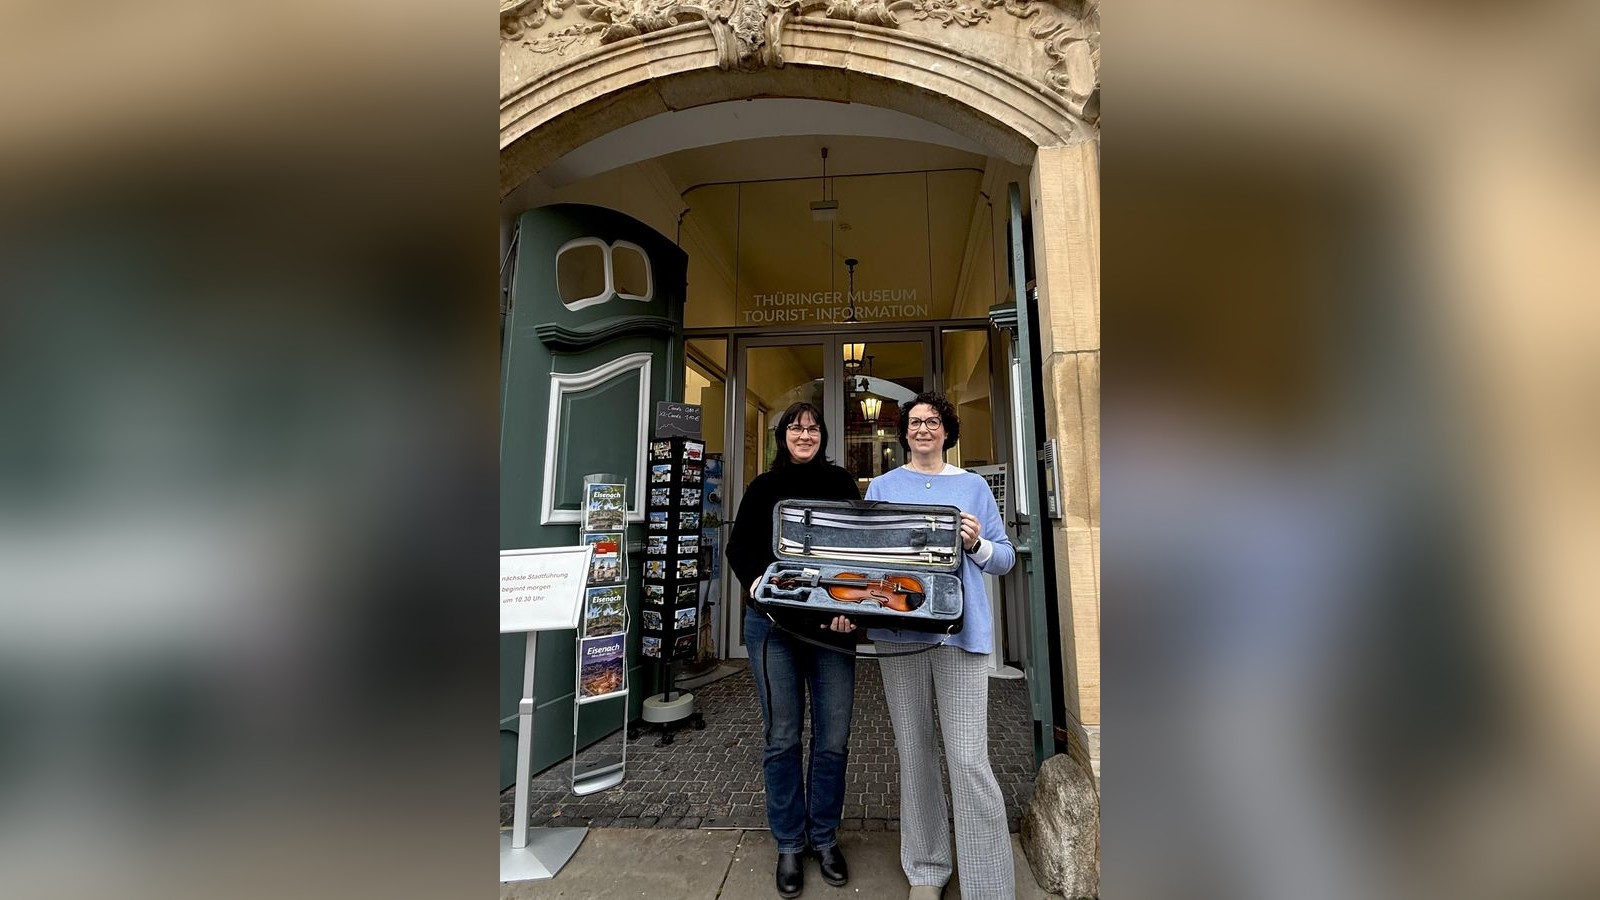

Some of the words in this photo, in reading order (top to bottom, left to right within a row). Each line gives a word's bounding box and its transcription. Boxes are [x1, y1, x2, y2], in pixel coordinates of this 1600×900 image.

[753, 291, 843, 307] THÜRINGER
[847, 289, 917, 304] MUSEUM
[742, 304, 928, 322] TOURIST-INFORMATION
[527, 572, 569, 580] Stadtführung
[501, 585, 526, 593] beginnt
[515, 595, 532, 603] 10.30
[592, 594, 622, 604] Eisenach
[586, 643, 620, 656] Eisenach
